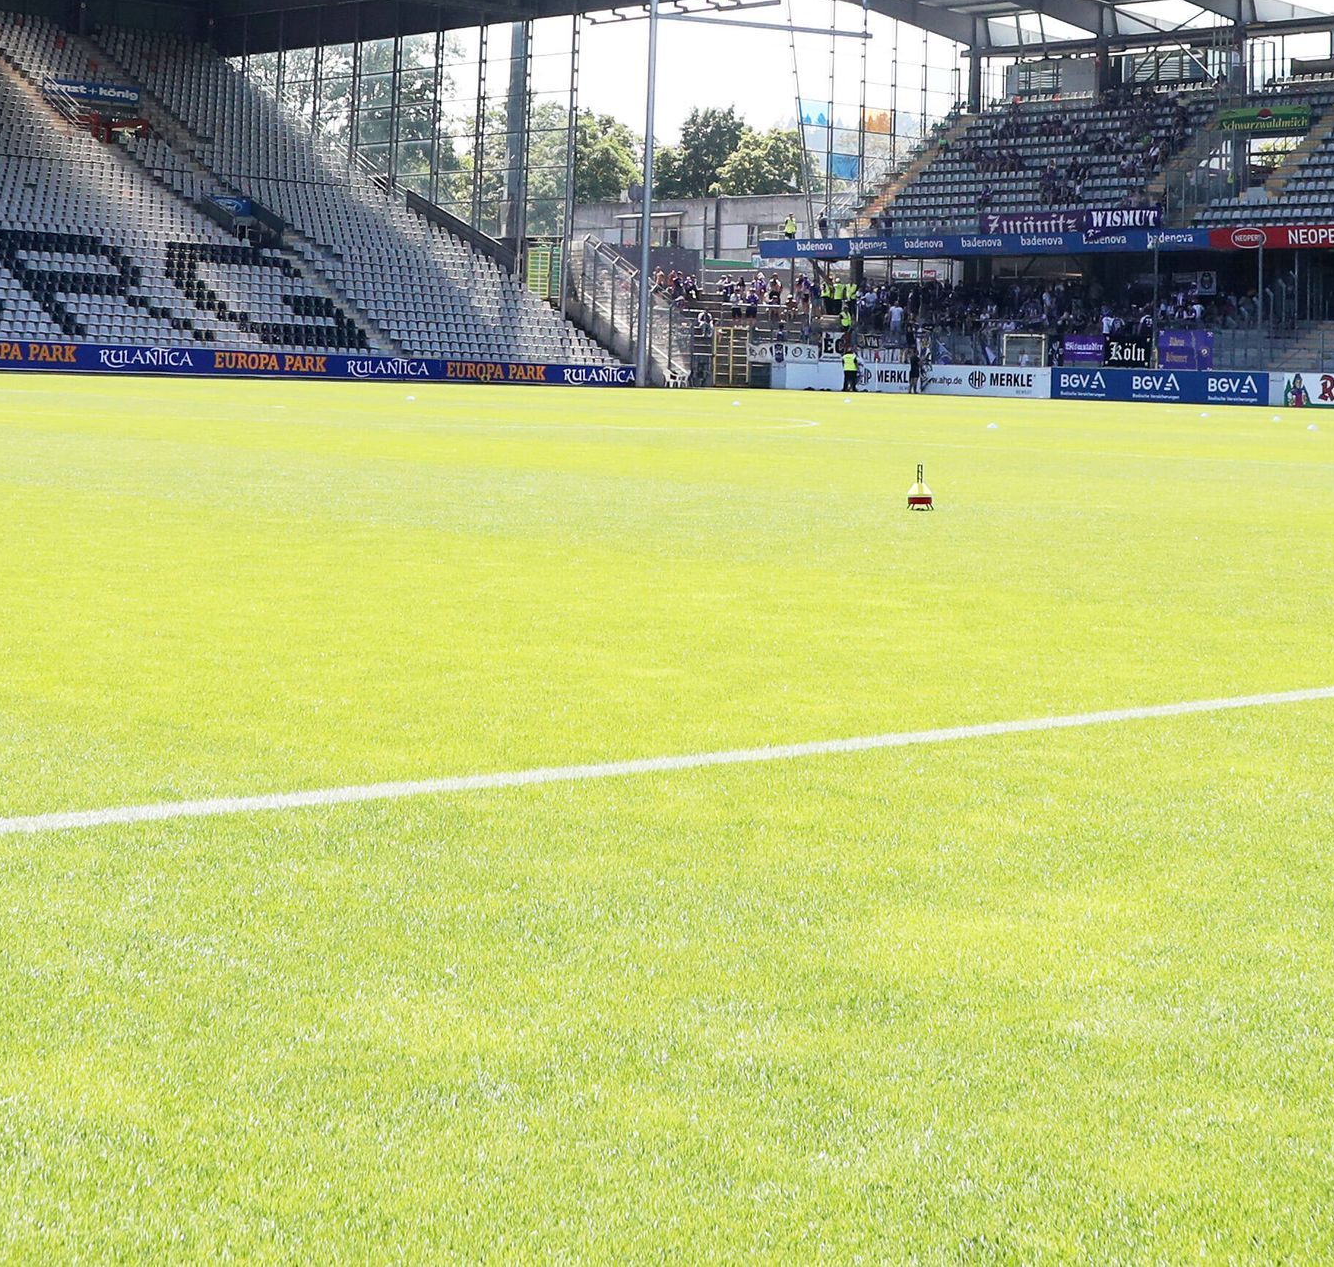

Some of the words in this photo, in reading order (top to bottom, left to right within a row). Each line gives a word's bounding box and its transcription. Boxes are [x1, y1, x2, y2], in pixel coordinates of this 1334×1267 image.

[98, 86, 139, 101] könig
[1222, 117, 1307, 130] Schwarzwaldmilch
[1091, 210, 1157, 227] WISMUT
[797, 240, 833, 251] badenova
[903, 238, 943, 248] badenova
[961, 237, 1002, 248] badenova
[1021, 234, 1063, 246] badenova
[28, 344, 77, 363] PARK
[99, 347, 193, 368] RULANTICA
[1109, 341, 1146, 361] Köln
[214, 352, 279, 371] EUROPA
[284, 355, 327, 372] PARK
[347, 358, 429, 378] RULANTICA
[447, 362, 504, 380] EUROPA
[508, 365, 546, 381] PARK
[564, 366, 636, 385] RULANTICA
[877, 369, 910, 384] MERKL
[989, 373, 1033, 387] MERKLE
